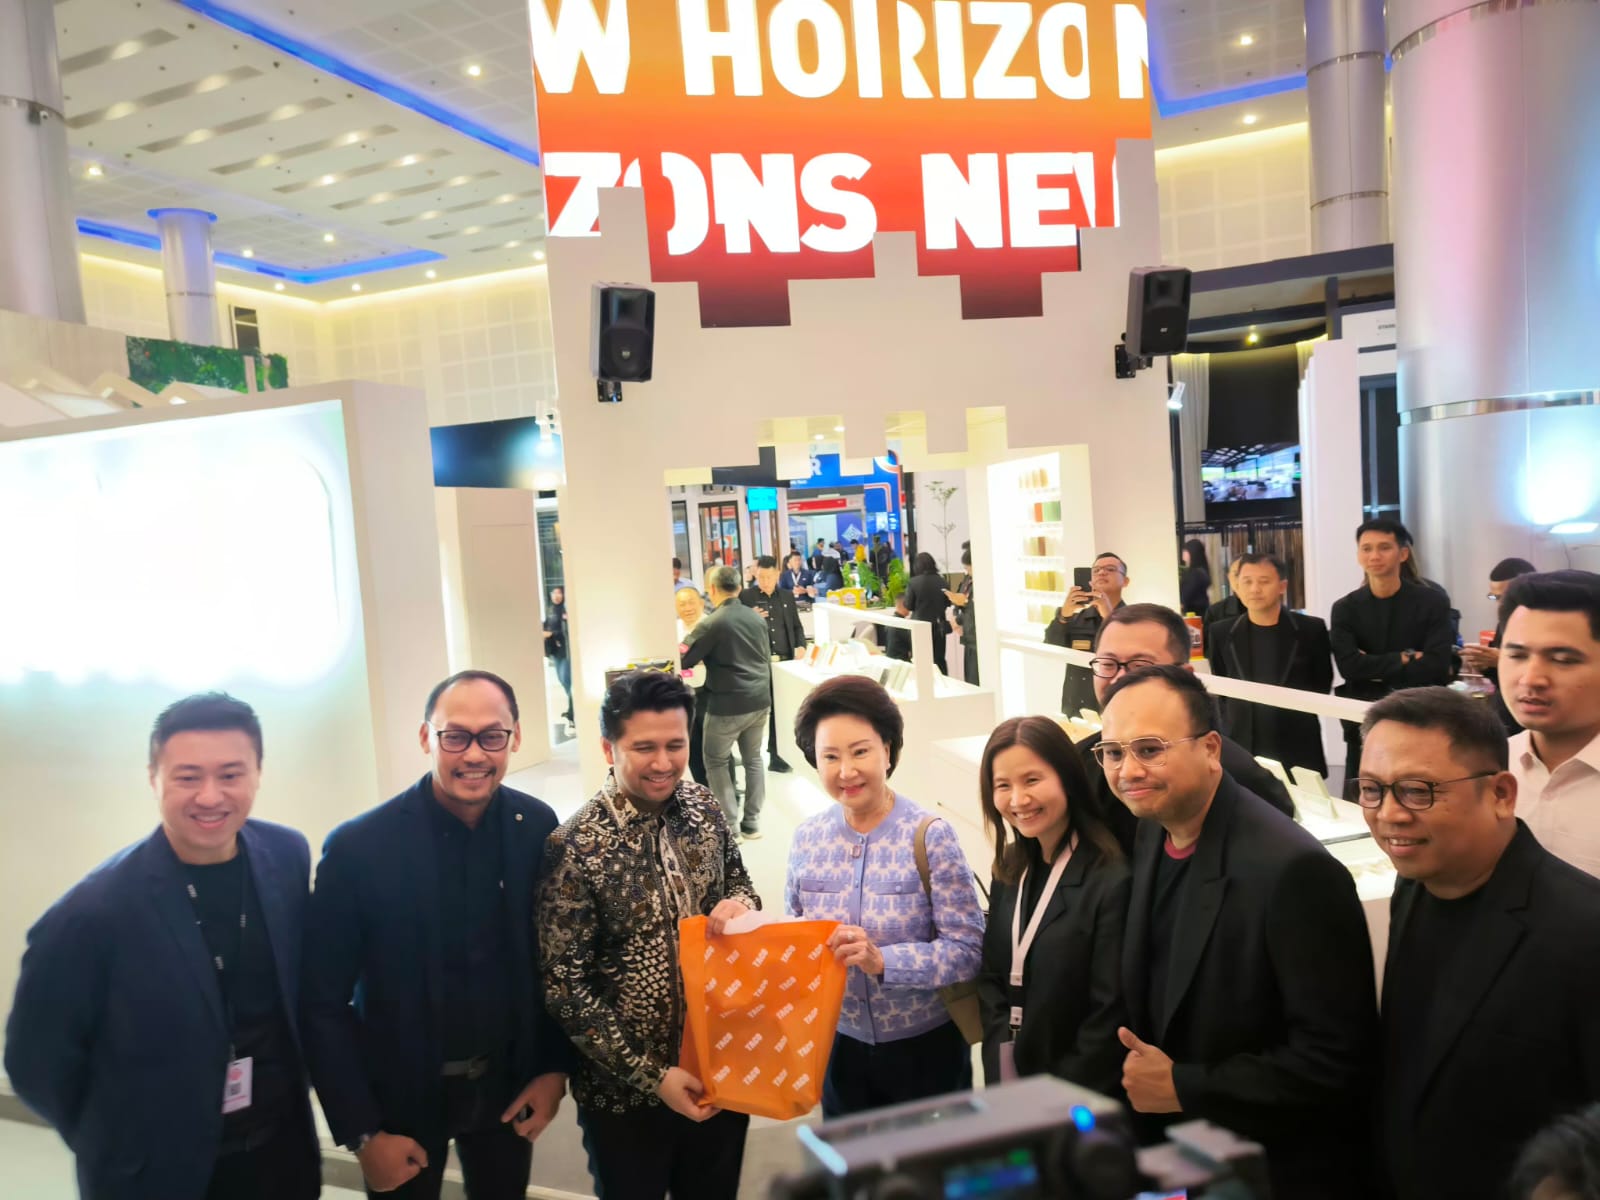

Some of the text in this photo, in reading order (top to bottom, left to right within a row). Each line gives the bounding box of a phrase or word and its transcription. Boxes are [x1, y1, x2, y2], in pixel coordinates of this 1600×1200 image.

[752, 948, 768, 967] TACO
[781, 945, 796, 963] TACO
[724, 979, 742, 997] TACO
[779, 976, 796, 991] TACO
[776, 1003, 794, 1020] TACO
[715, 1032, 733, 1050] TACO
[745, 1033, 763, 1051] TACO
[713, 1065, 731, 1082] TACO
[743, 1066, 760, 1085] TACO
[792, 1073, 809, 1090] TACO
